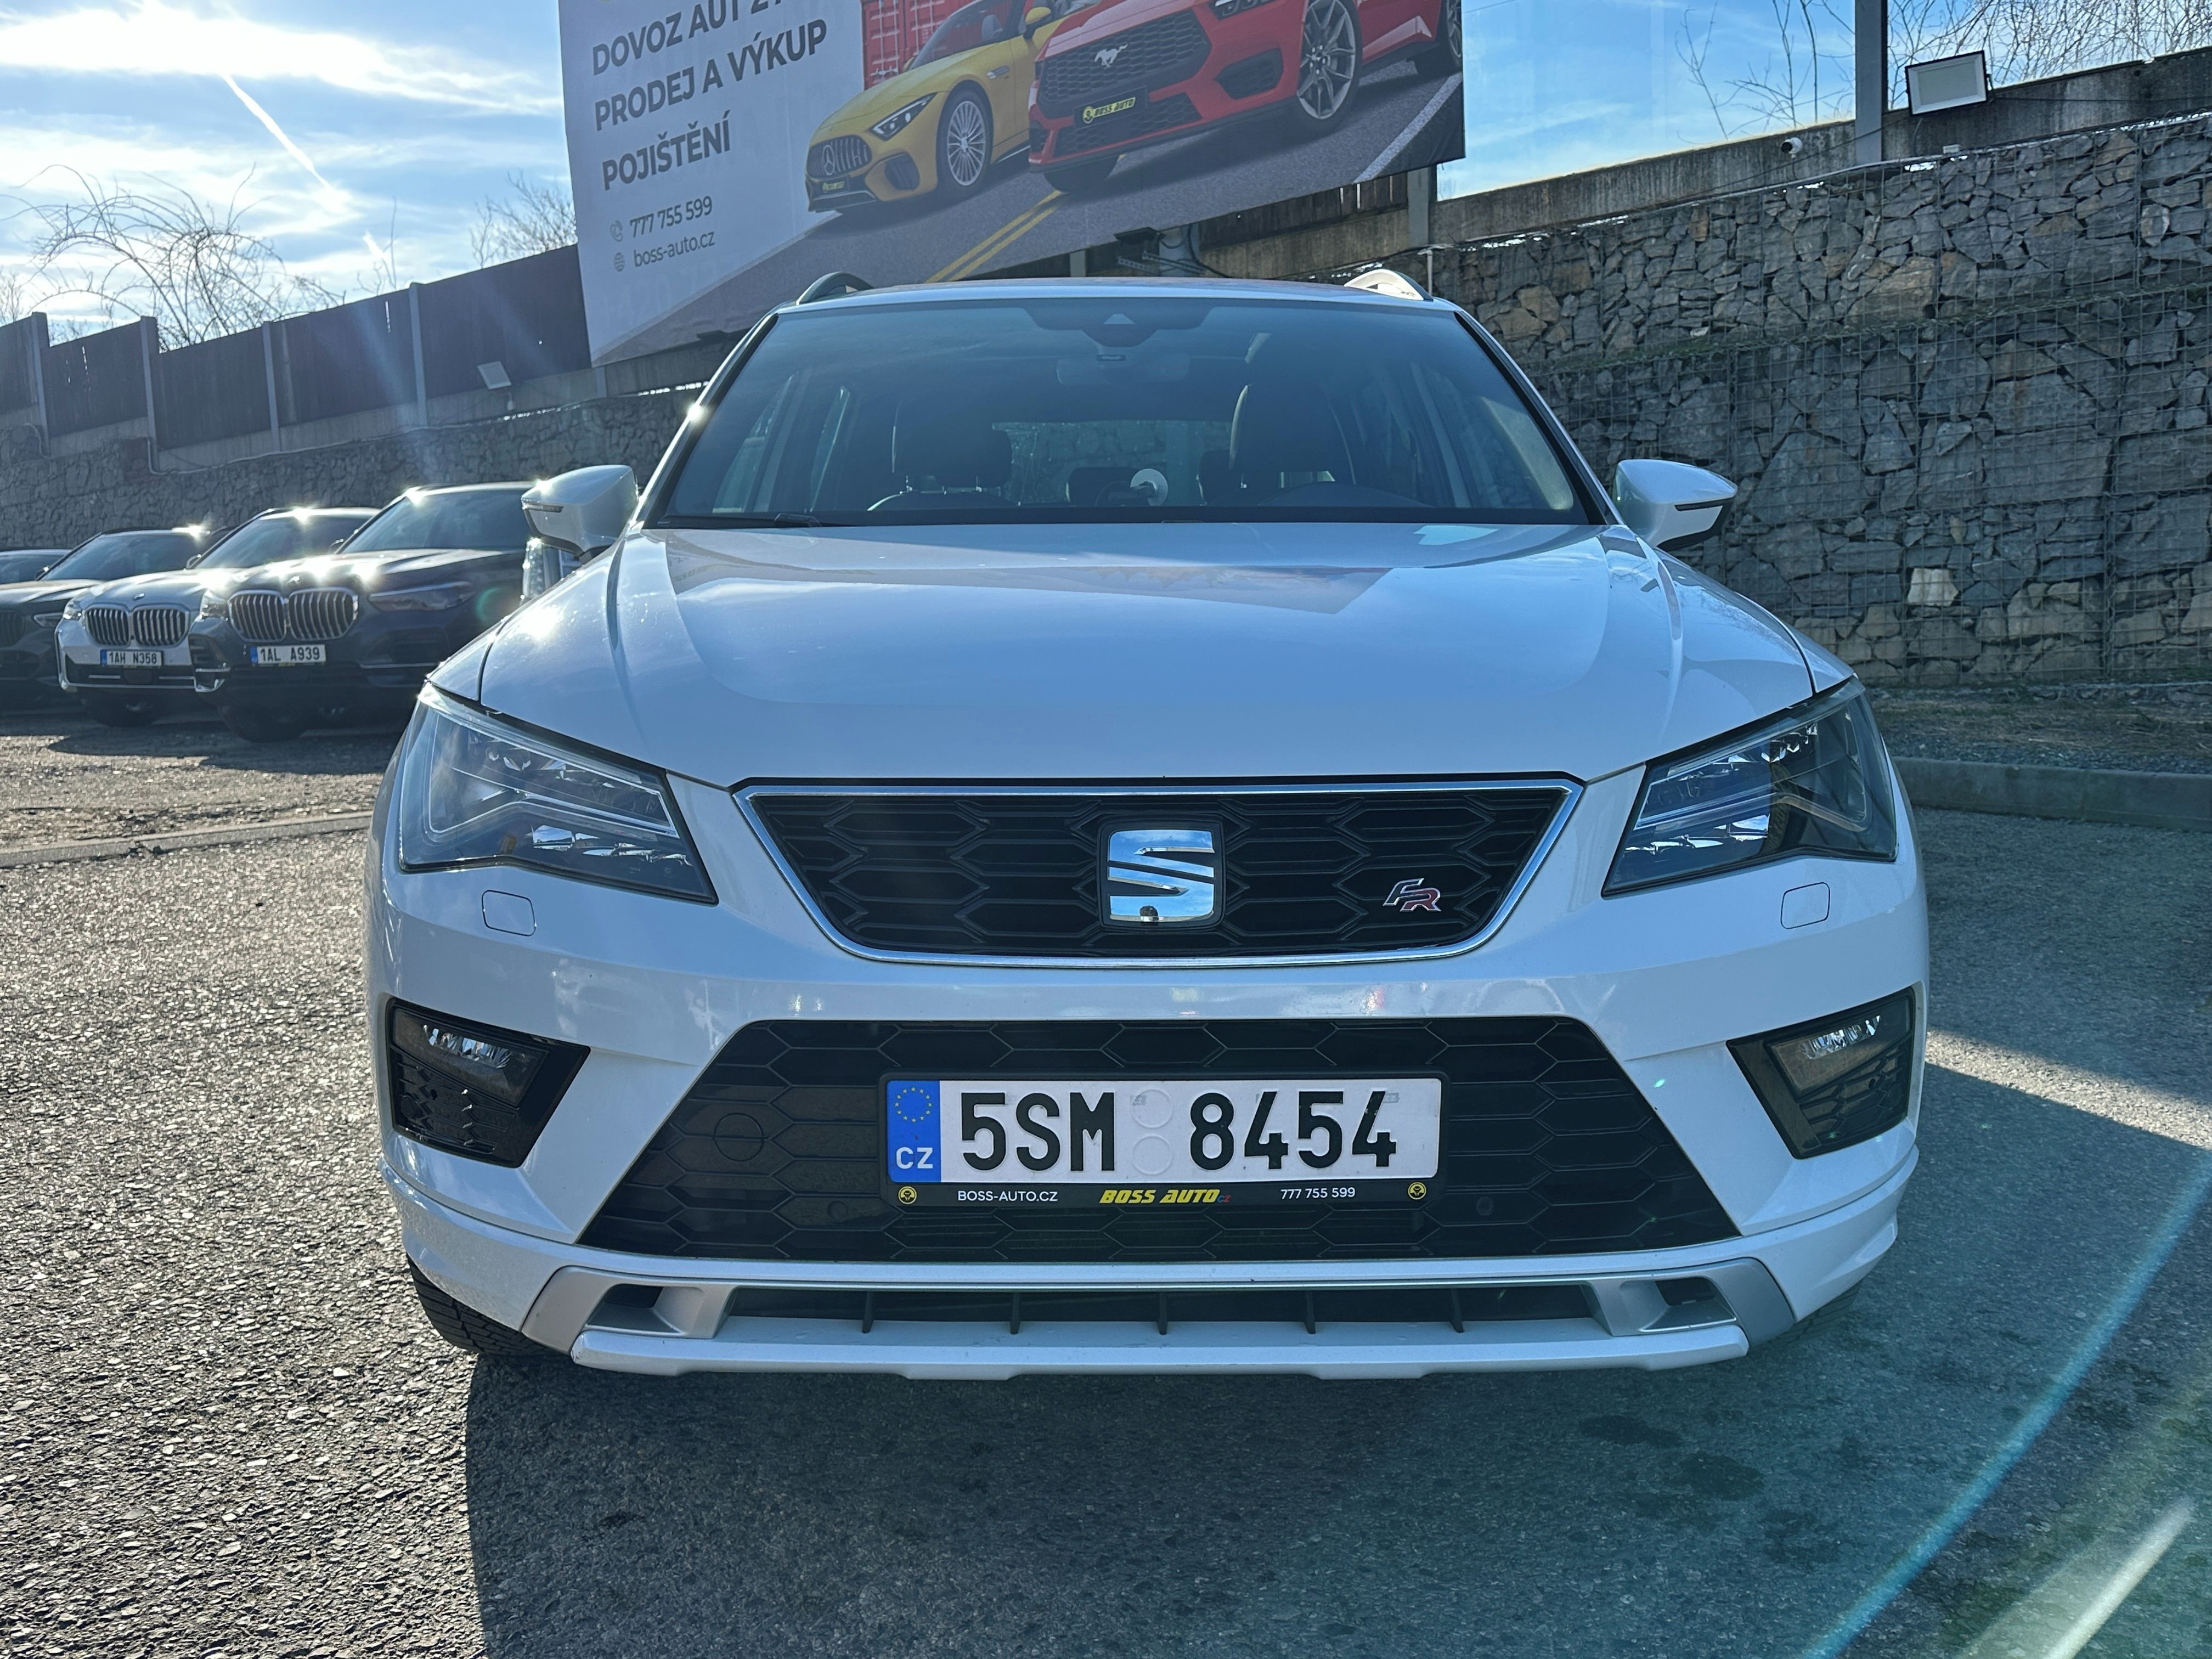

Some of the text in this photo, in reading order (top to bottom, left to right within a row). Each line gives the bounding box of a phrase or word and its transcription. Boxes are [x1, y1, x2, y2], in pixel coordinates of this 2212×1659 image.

[592, 12, 682, 76] DOVOZ
[595, 19, 827, 132] PRODEJ A VÝKUP
[602, 110, 731, 191] POJIŠTĚNÍ
[629, 195, 713, 238] 777 755 599
[633, 230, 715, 267] boss-auto.cz
[109, 651, 126, 663] 1AH
[133, 652, 157, 664] N358
[261, 648, 281, 662] 1AL
[290, 647, 320, 661] A939
[1382, 877, 1442, 912] FR
[961, 1091, 1397, 1171] 5SM 8454
[896, 1147, 933, 1169] CZ
[958, 1190, 1058, 1202] BOSS-AUTO.CZ
[1099, 1189, 1157, 1204] BOSS
[1159, 1189, 1220, 1203] AUTO
[1280, 1187, 1356, 1199] 777 755 599
